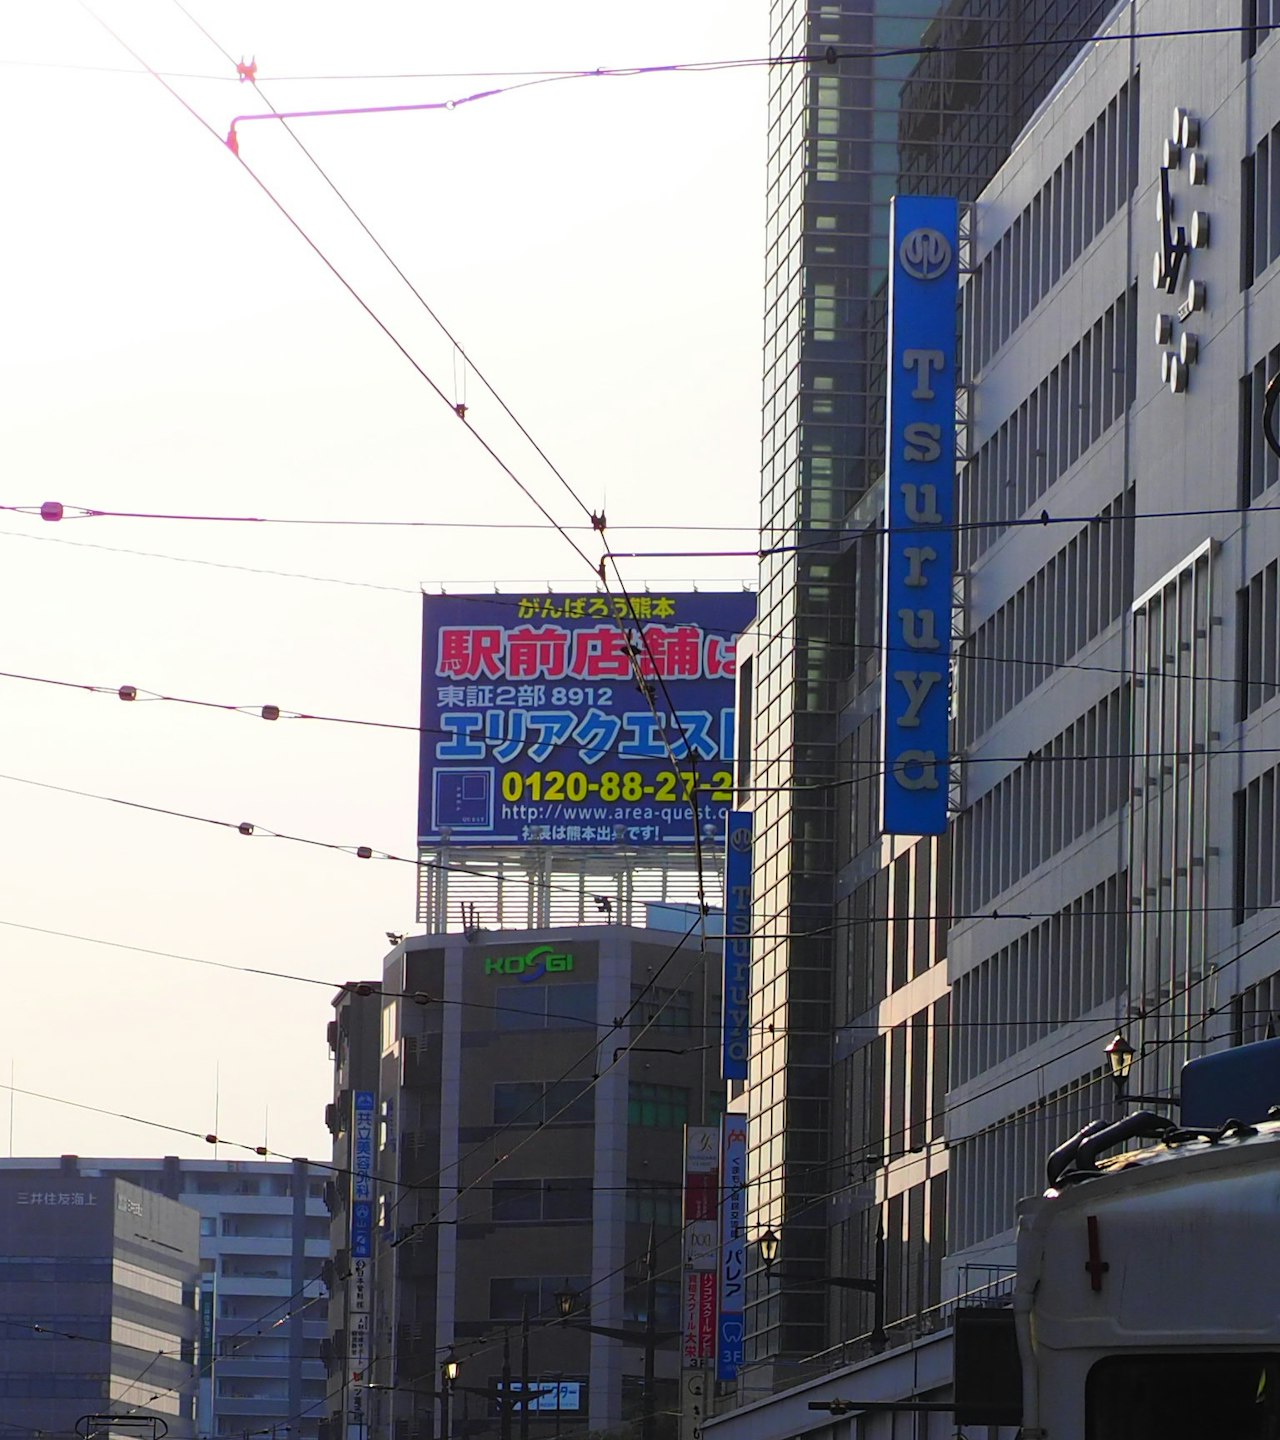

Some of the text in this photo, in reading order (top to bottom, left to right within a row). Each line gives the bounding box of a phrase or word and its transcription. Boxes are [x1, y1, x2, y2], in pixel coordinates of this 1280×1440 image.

[894, 348, 945, 791] Tsuruya
[518, 596, 676, 620] がんばろう熊本
[436, 624, 738, 681] 駅前店舗は
[436, 685, 613, 708] 東証2部 8912
[16, 1191, 98, 1207] 三井住友海上
[726, 1249, 743, 1297] パレア
[722, 1350, 742, 1364] 3F
